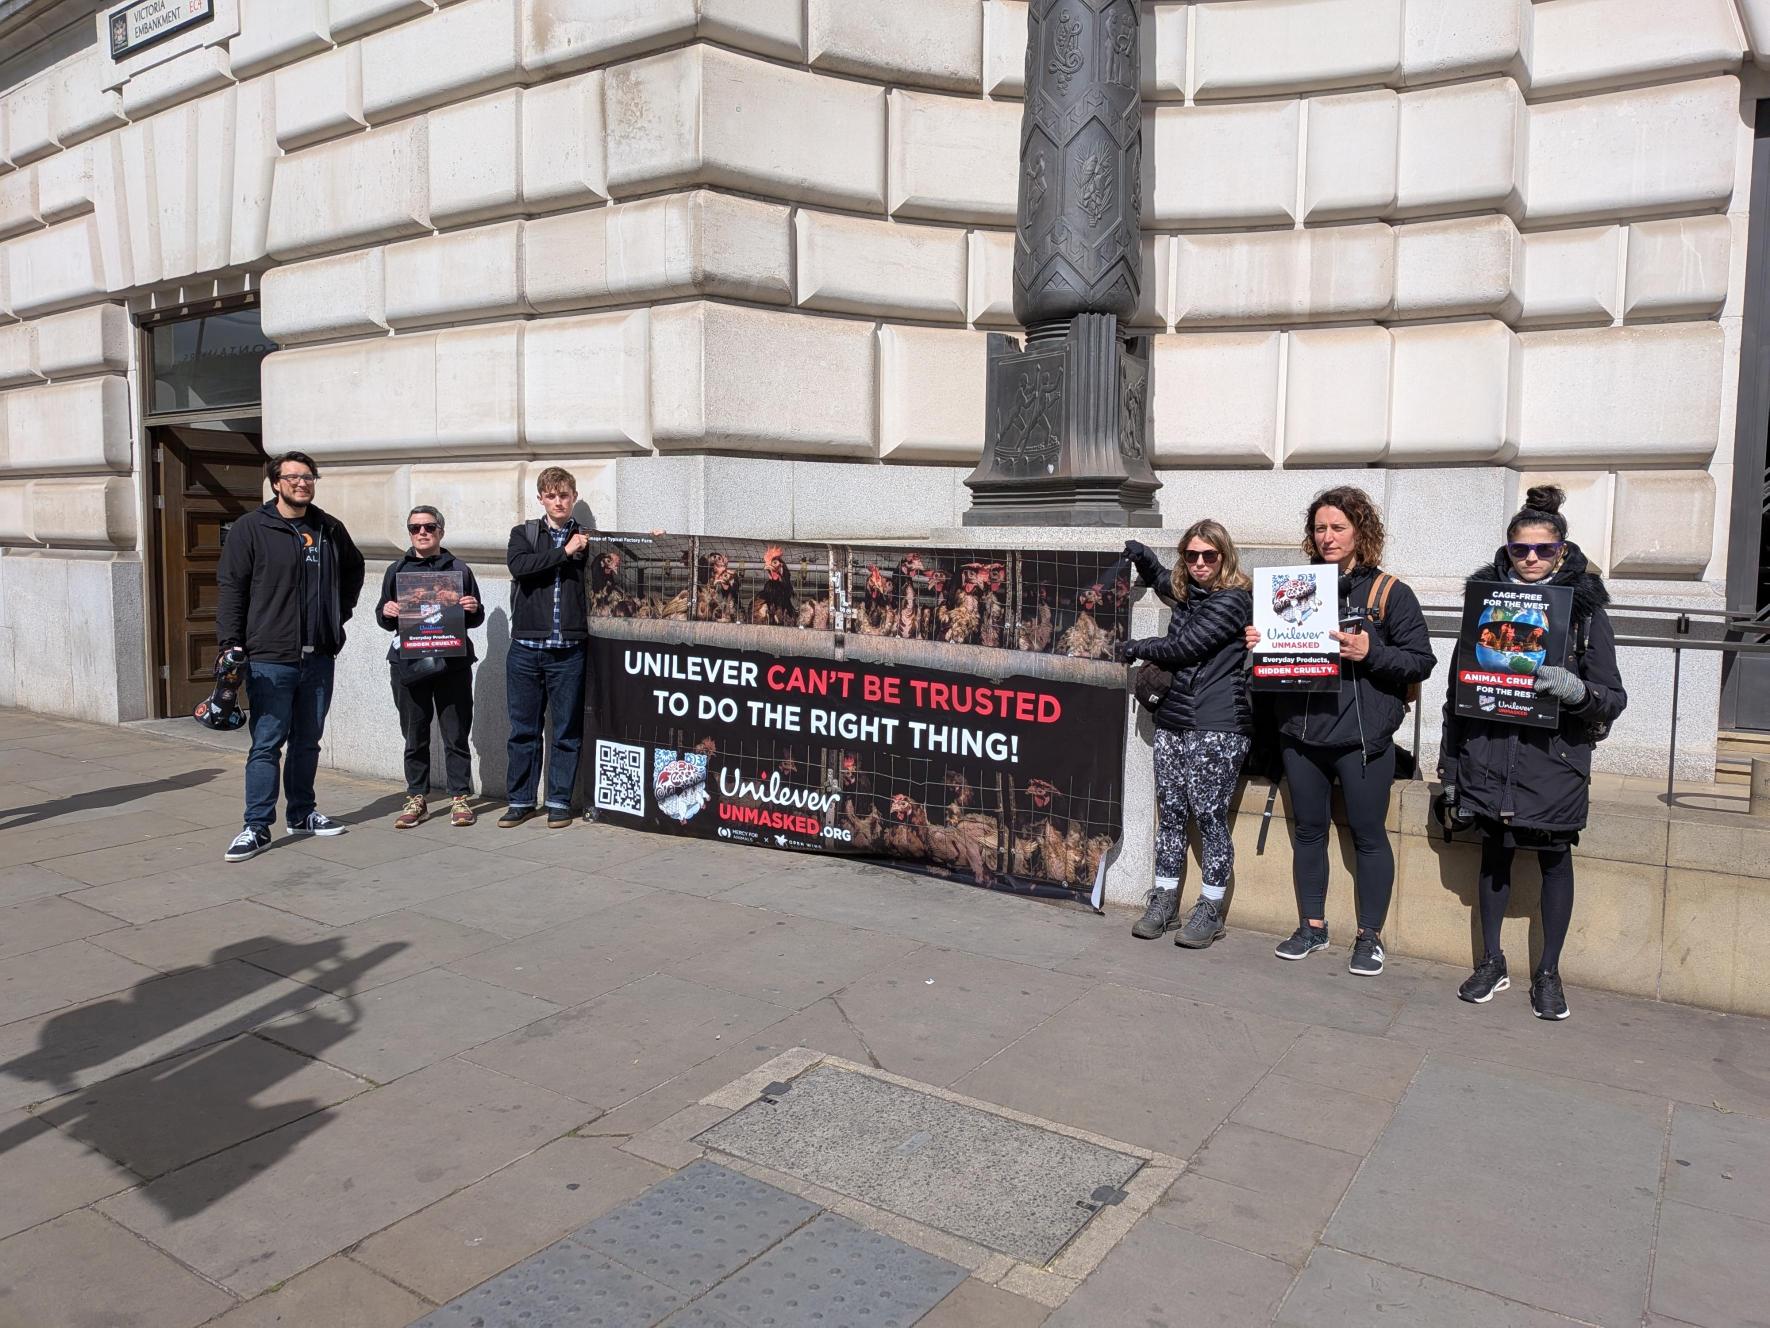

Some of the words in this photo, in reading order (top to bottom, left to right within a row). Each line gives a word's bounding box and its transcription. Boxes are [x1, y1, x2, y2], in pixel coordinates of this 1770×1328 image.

[134, 0, 166, 23] VICTORIA
[134, 7, 181, 38] EMBANKMENT
[1492, 591, 1542, 601] CAGE-FREE
[1504, 600, 1521, 608] THE
[1523, 602, 1550, 610] WEST
[1267, 627, 1324, 640] Unilever
[1262, 656, 1295, 664] Everyday
[1293, 666, 1335, 674] CRUELTY.
[1464, 673, 1503, 684] ANIMAL
[1505, 676, 1534, 685] CRUE
[624, 650, 759, 688] UNILEVER
[766, 664, 855, 698] CAN'T
[863, 674, 901, 704] BE
[910, 680, 1062, 723] TRUSTED
[1476, 685, 1494, 693] FOR
[1496, 687, 1513, 695] THE
[1514, 690, 1538, 699] REST.
[1498, 700, 1534, 712] Unilever
[652, 690, 689, 717] TO
[698, 695, 738, 723] DO
[747, 700, 801, 731] THE
[810, 708, 899, 745] RIGHT
[908, 721, 1019, 763] THING!
[719, 766, 841, 812] Unilever
